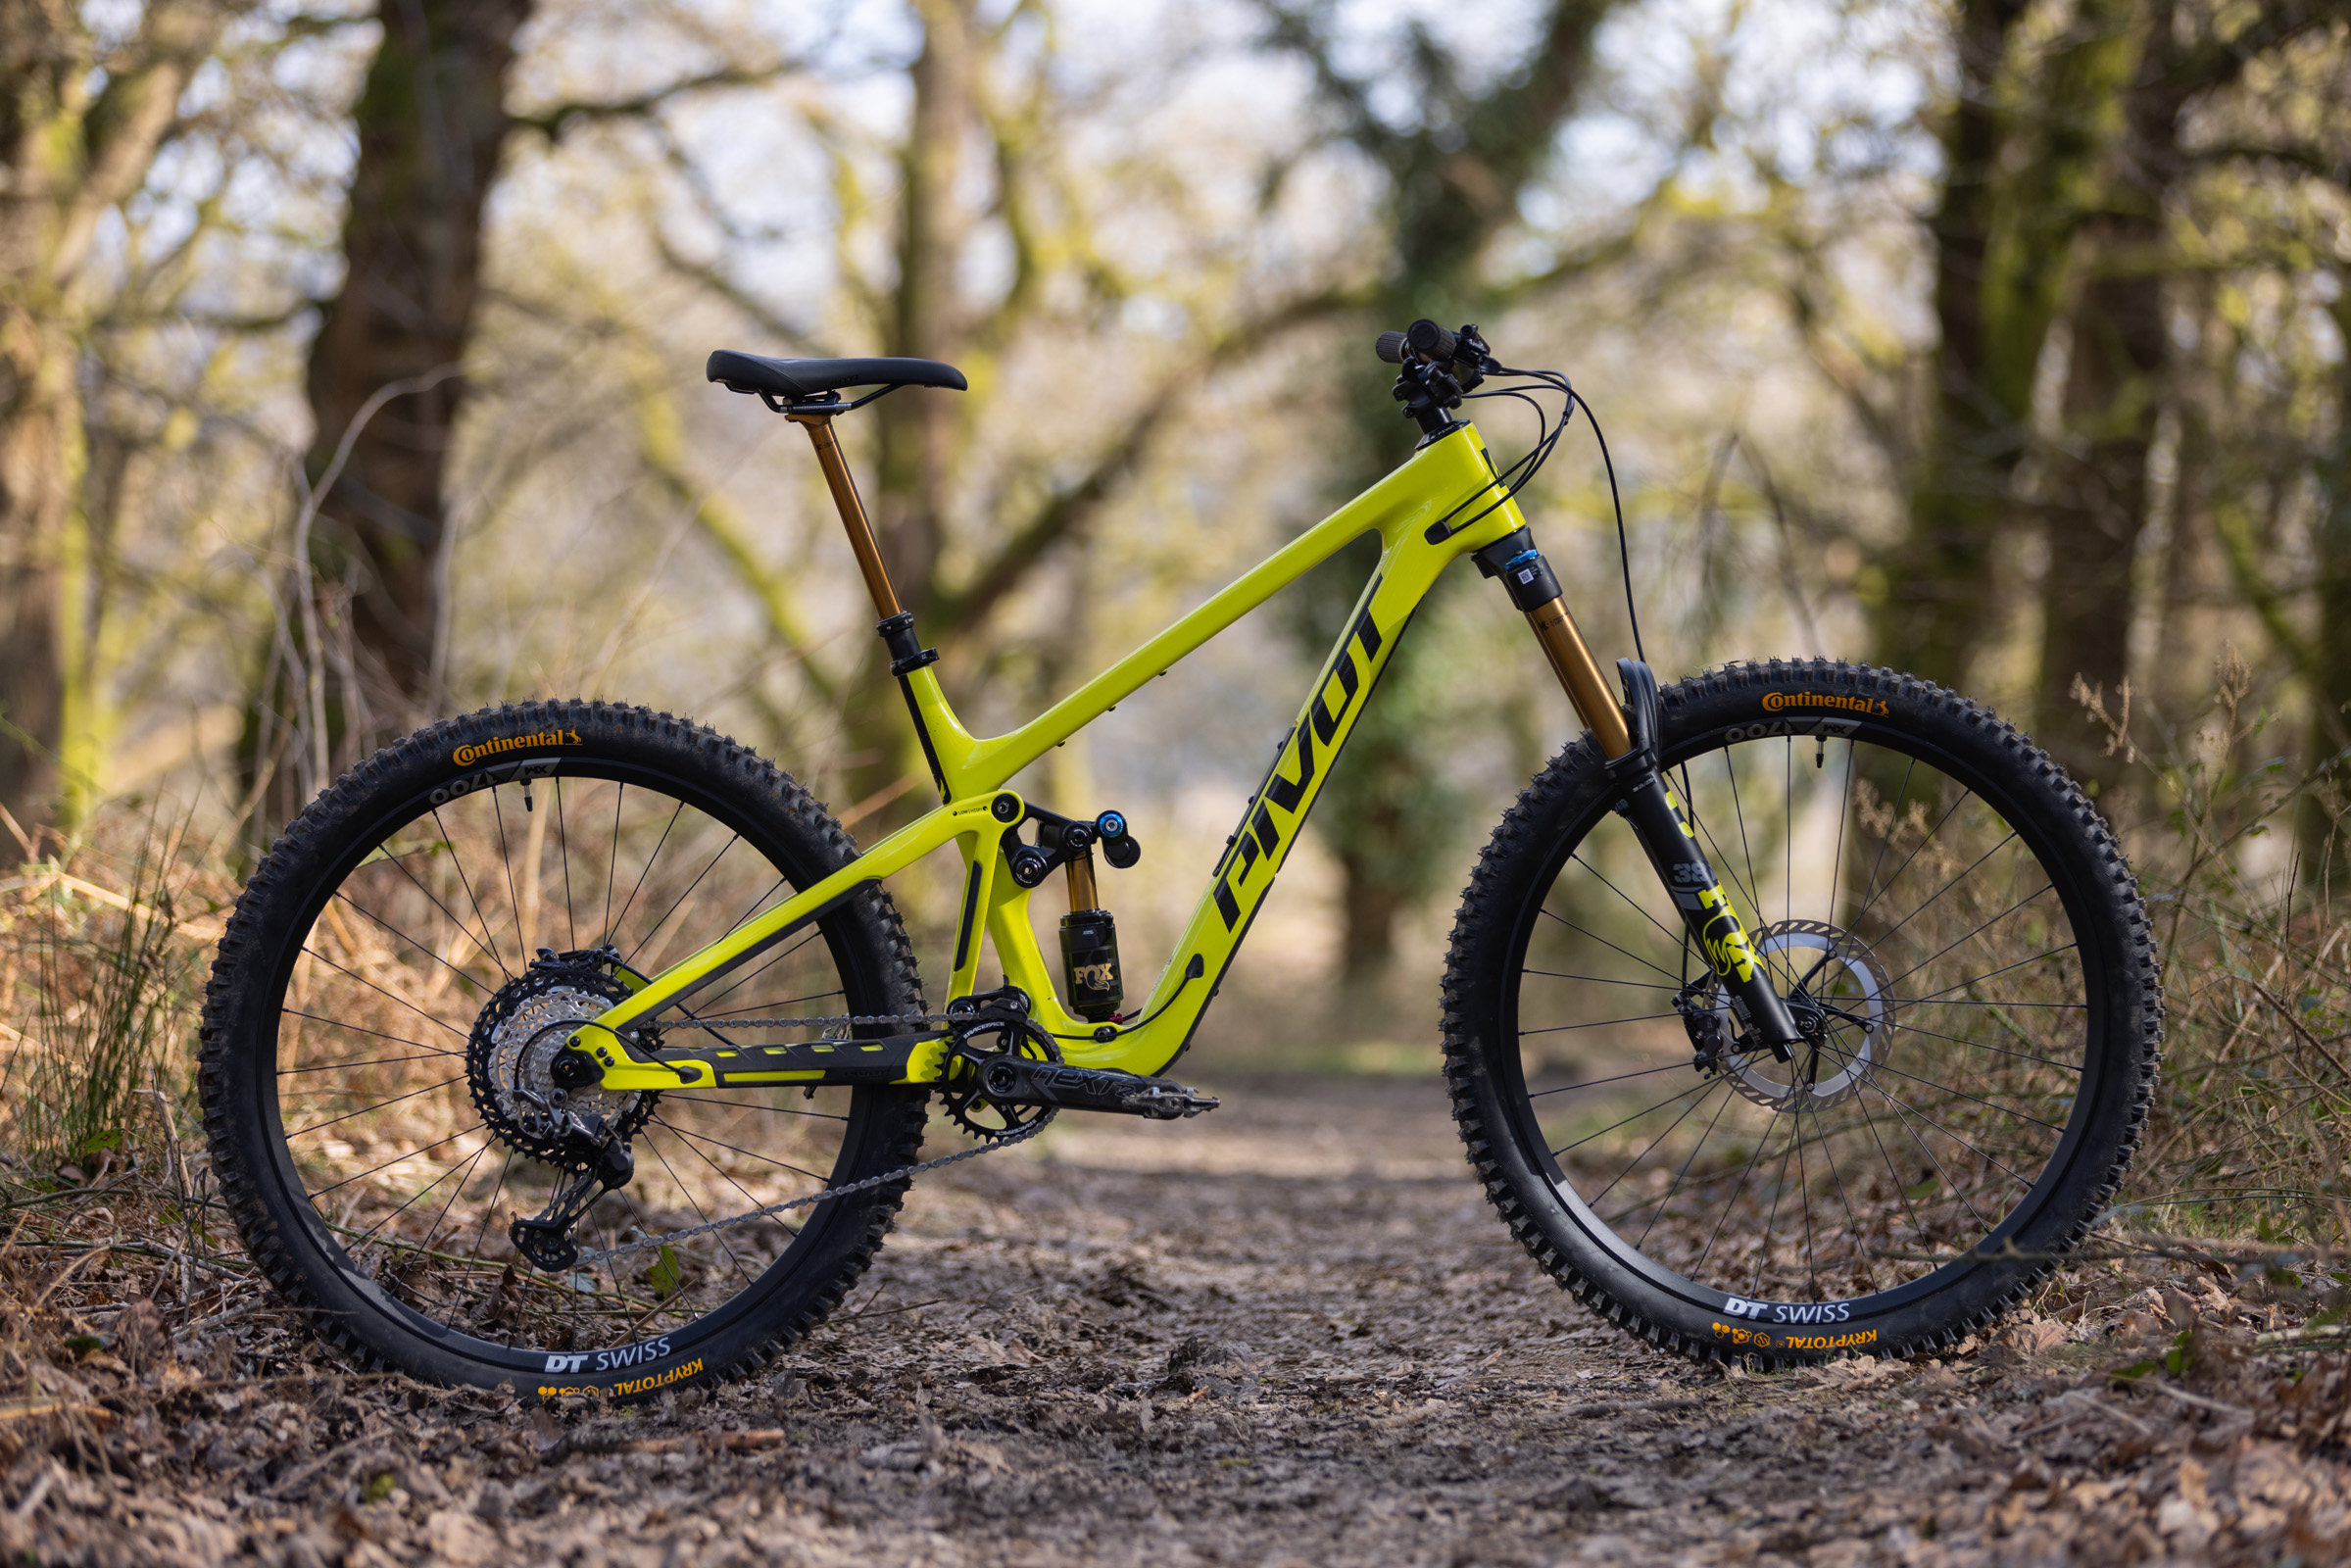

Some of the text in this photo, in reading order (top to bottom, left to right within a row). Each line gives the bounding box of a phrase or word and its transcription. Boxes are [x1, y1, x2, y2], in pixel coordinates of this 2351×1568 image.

[1762, 691, 1874, 713] Continental
[453, 729, 564, 766] Continental
[1725, 721, 1794, 743] 1700
[1213, 572, 1384, 934] PIVOT
[429, 771, 497, 805] 1700
[1697, 883, 1765, 983] FOX
[1073, 963, 1113, 991] FOX
[1723, 1297, 1850, 1324] DT SWISS
[545, 1337, 671, 1374] DT SWISS
[1786, 1329, 1878, 1349] KRYPTOTAL
[613, 1357, 704, 1396] KRYPTOTAL
